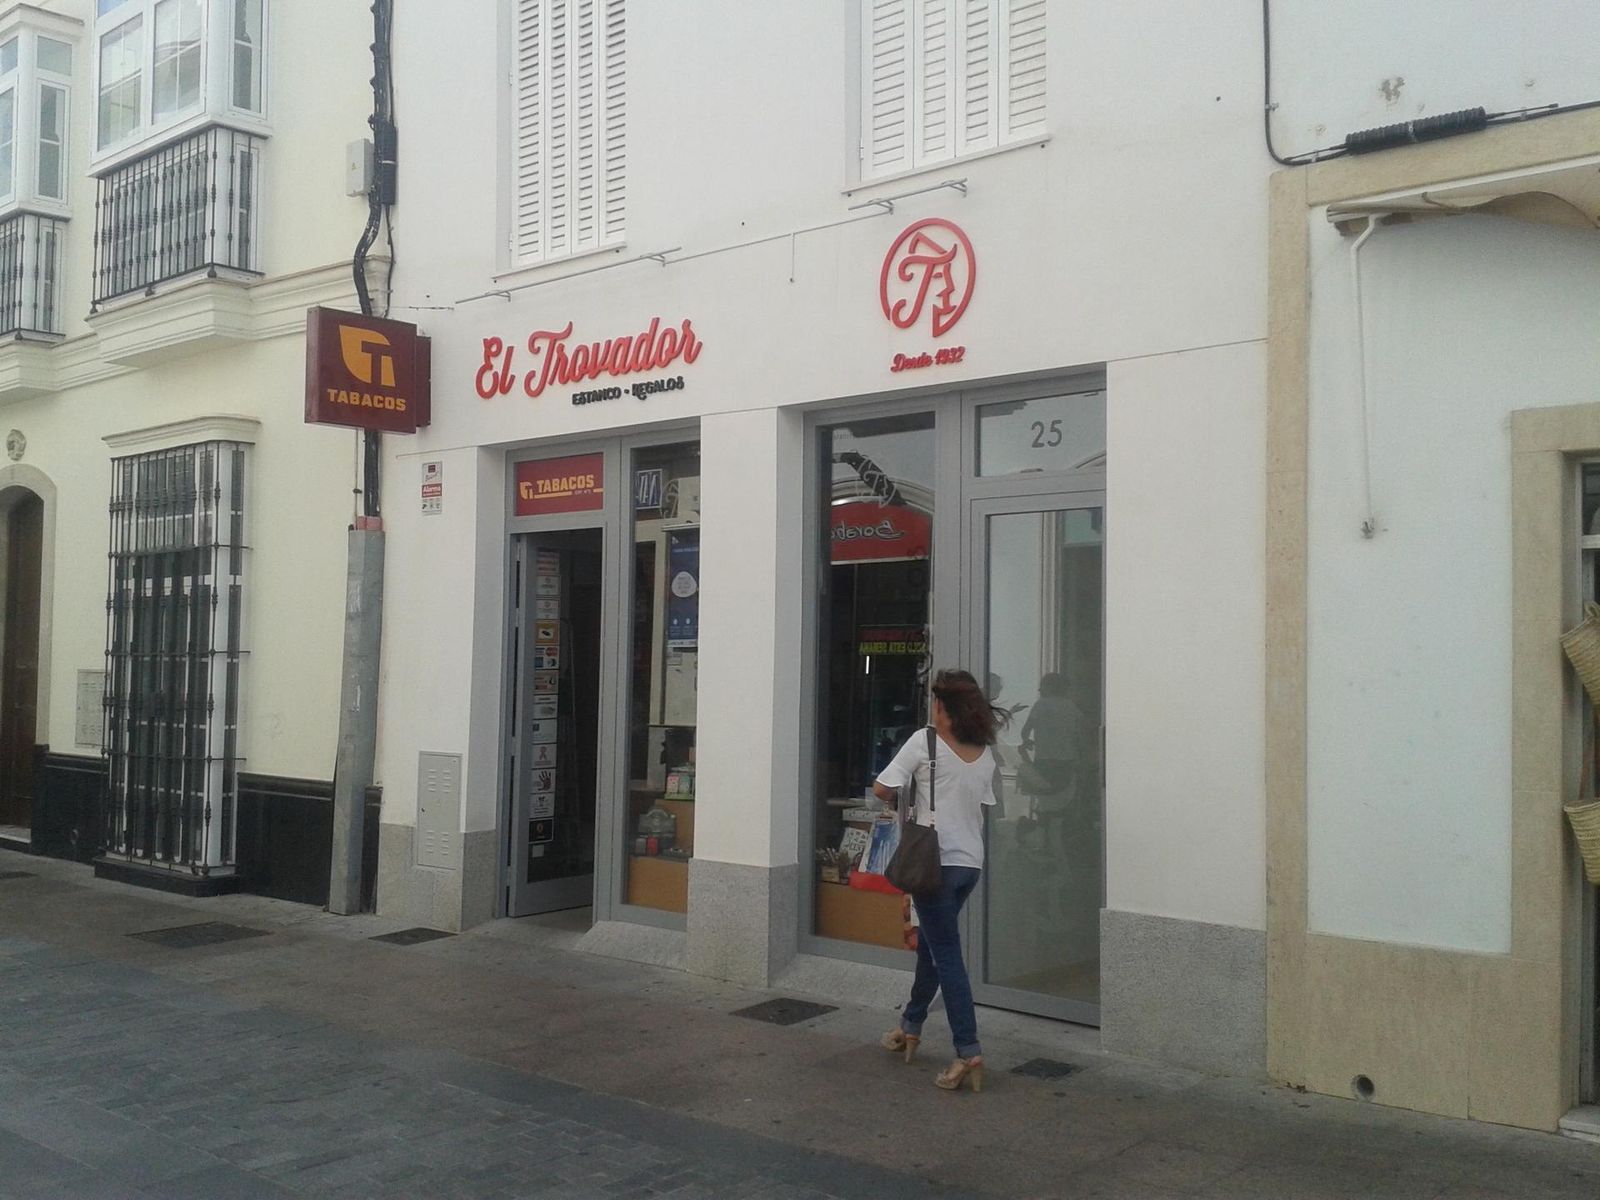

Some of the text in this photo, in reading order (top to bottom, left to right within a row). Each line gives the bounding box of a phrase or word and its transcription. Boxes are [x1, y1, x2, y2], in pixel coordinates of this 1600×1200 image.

[475, 318, 703, 398] El Trovador
[891, 346, 965, 373] Desde 1932
[326, 388, 408, 412] TABACOS
[571, 376, 685, 406] ESTANCO REGALOS
[1030, 419, 1063, 449] 25
[536, 474, 595, 493] TABACOS
